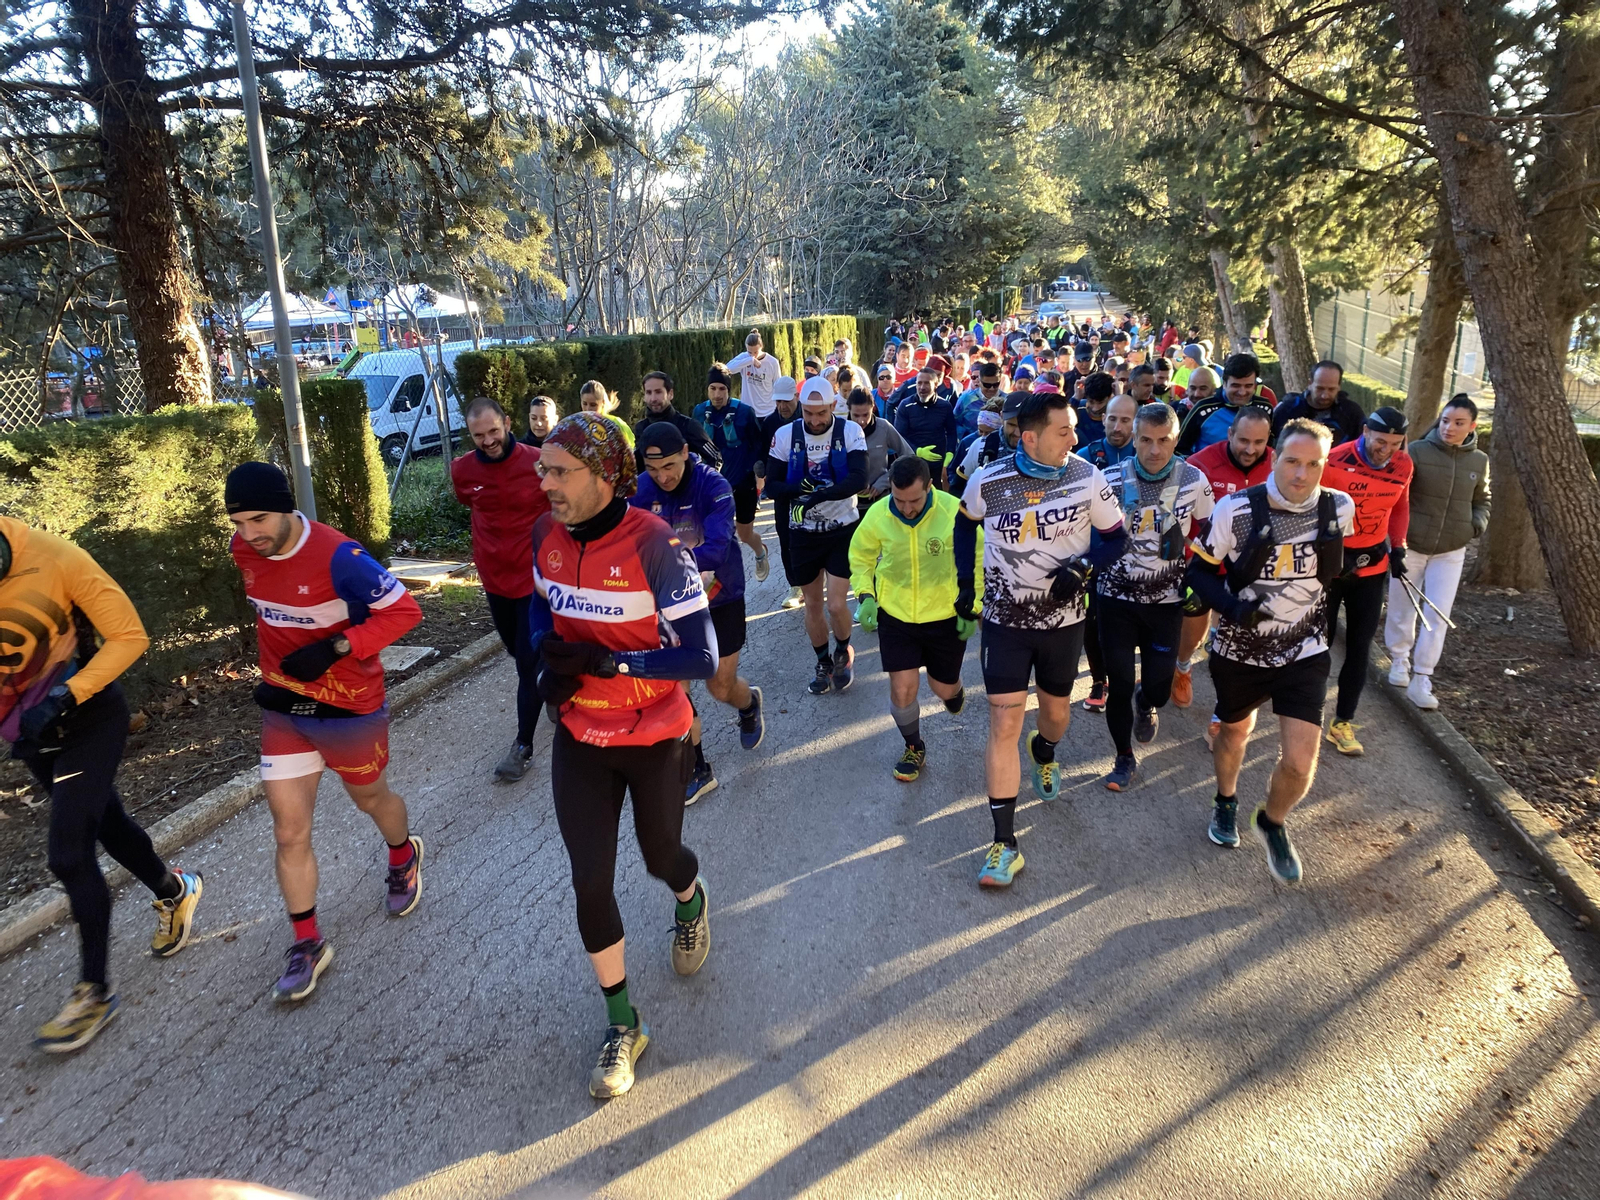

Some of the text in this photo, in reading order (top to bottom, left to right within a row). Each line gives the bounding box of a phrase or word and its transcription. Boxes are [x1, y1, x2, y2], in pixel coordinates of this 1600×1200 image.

[1348, 481, 1368, 491] CXM
[992, 506, 1079, 532] JABALCUZ
[999, 520, 1052, 544] TRAIL
[603, 579, 629, 588] TOMÁS
[565, 594, 624, 617] Avanza
[264, 607, 316, 625] Avanza
[586, 727, 616, 738] COMP
